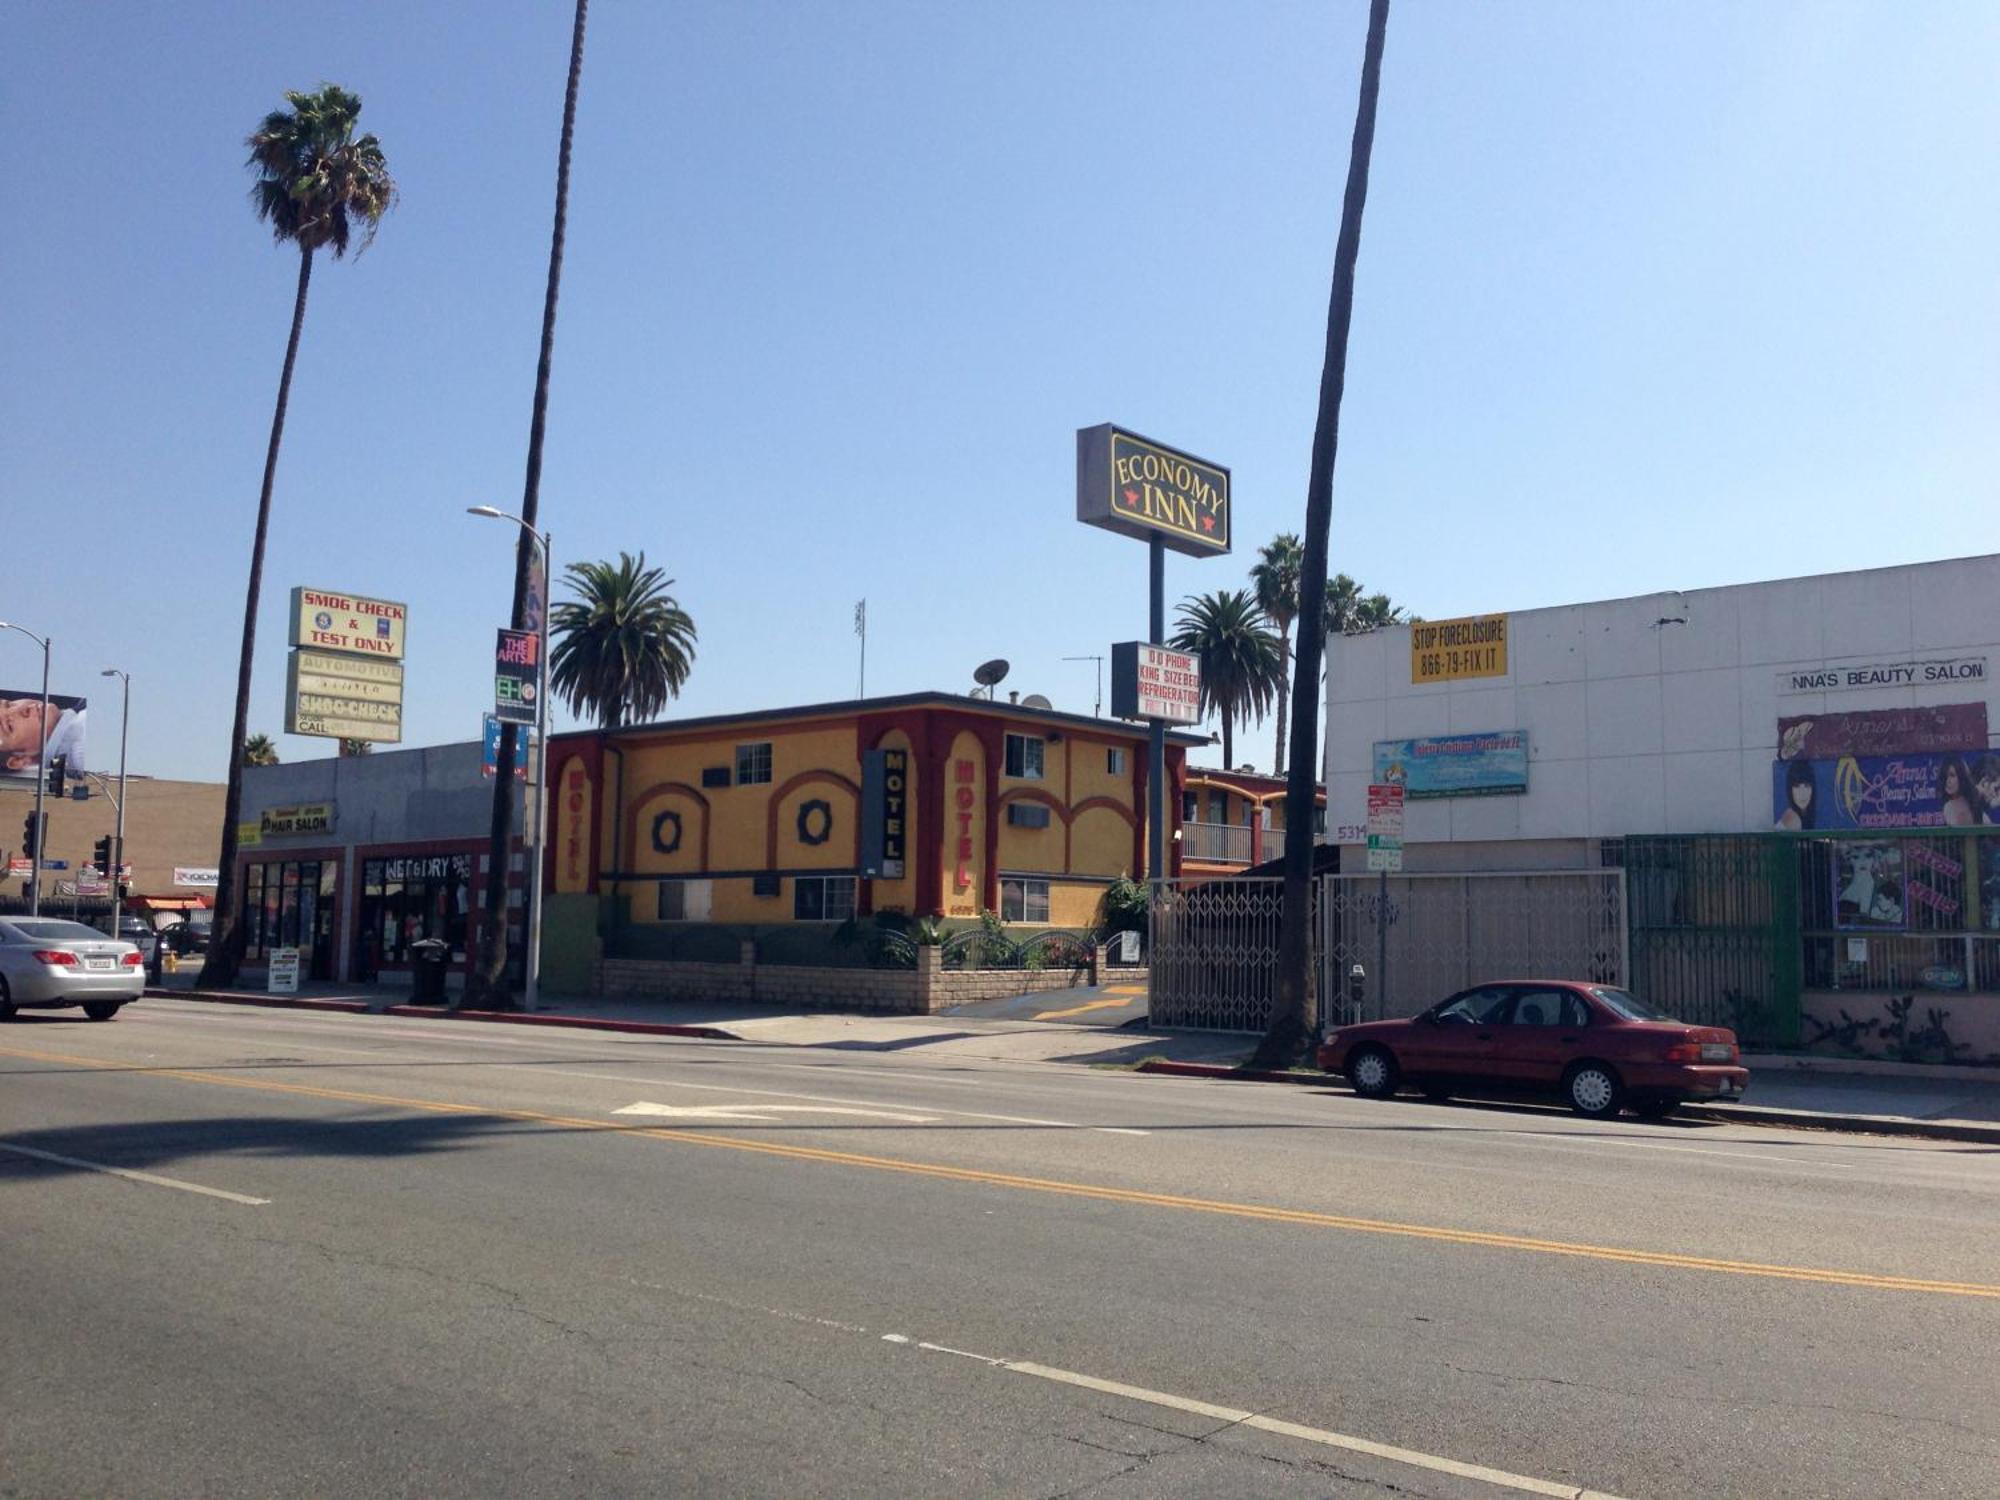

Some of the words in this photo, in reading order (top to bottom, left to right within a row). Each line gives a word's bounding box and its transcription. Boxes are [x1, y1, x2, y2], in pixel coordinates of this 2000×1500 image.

[1116, 455, 1223, 515] ECONOMY
[1142, 483, 1198, 531] INN
[305, 593, 350, 611] SMOG
[356, 602, 403, 619] CHECK
[349, 619, 359, 630] &
[1414, 628, 1436, 650] STOP
[1439, 619, 1503, 647] FORECLOSURE
[311, 631, 349, 646] TEST
[355, 639, 395, 653] ONLY
[505, 638, 528, 653] THE
[498, 649, 527, 664] ARTS
[1164, 669, 1182, 685] SIZE
[1792, 673, 1838, 689] NNA'S
[1847, 668, 1915, 686] BEAUTY
[1925, 663, 1983, 681] SALON
[299, 722, 327, 733] CALL
[886, 753, 904, 857] MOTEL
[296, 816, 327, 832] SALON
[956, 760, 975, 887] MOTEL
